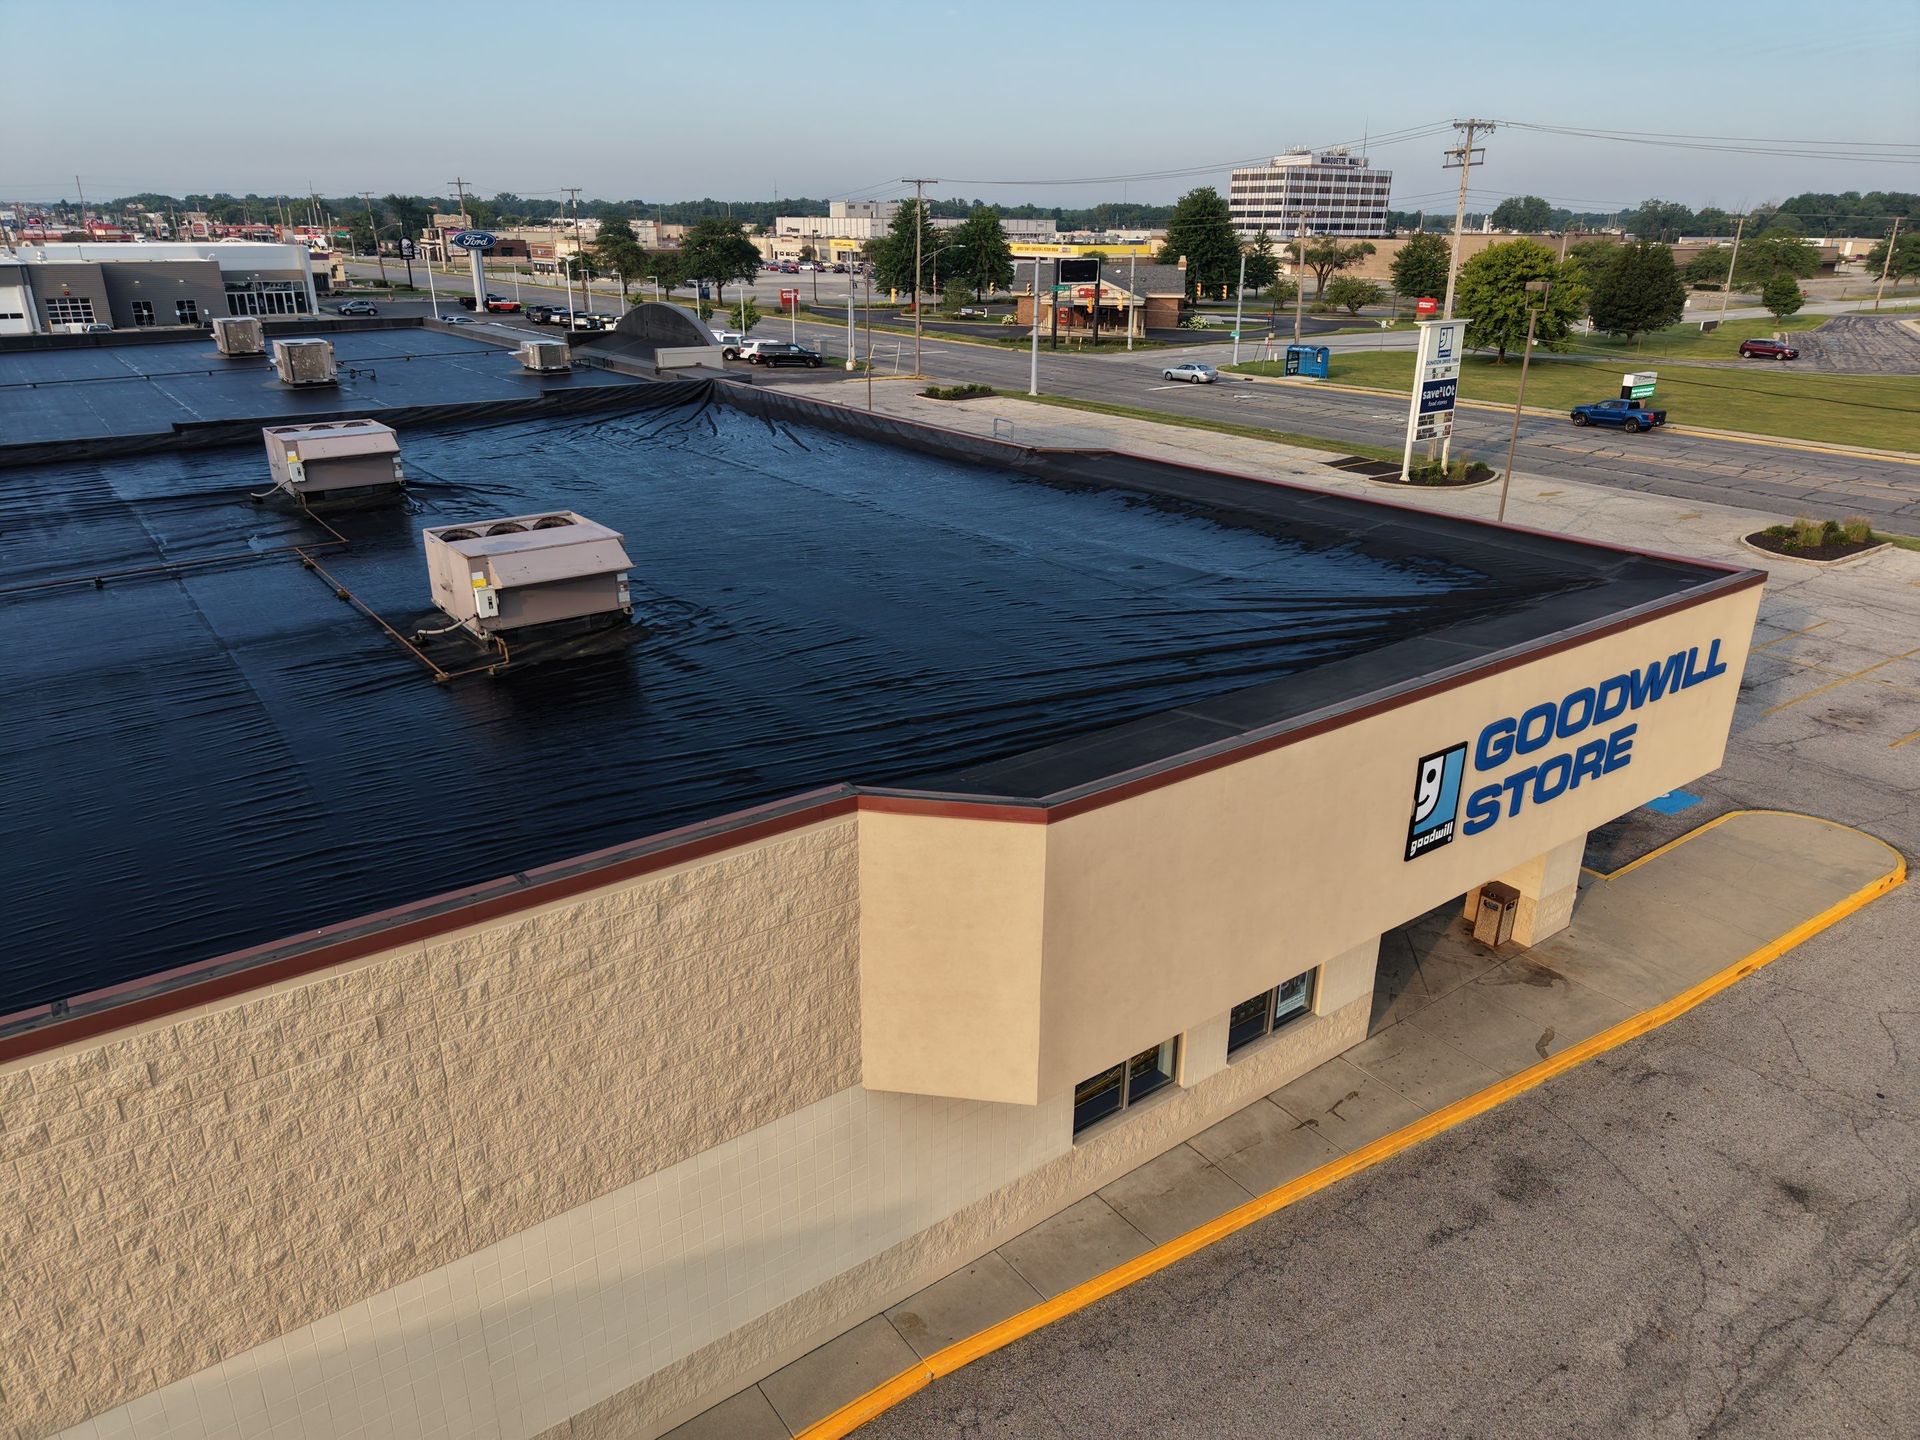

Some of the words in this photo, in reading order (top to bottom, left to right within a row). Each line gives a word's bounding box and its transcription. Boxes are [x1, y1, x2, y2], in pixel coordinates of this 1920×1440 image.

[463, 234, 489, 246] Ford
[1422, 389, 1440, 400] save
[1474, 638, 1728, 772] GOODWILL
[1463, 723, 1638, 836] STORE
[1409, 821, 1454, 857] goodwill
